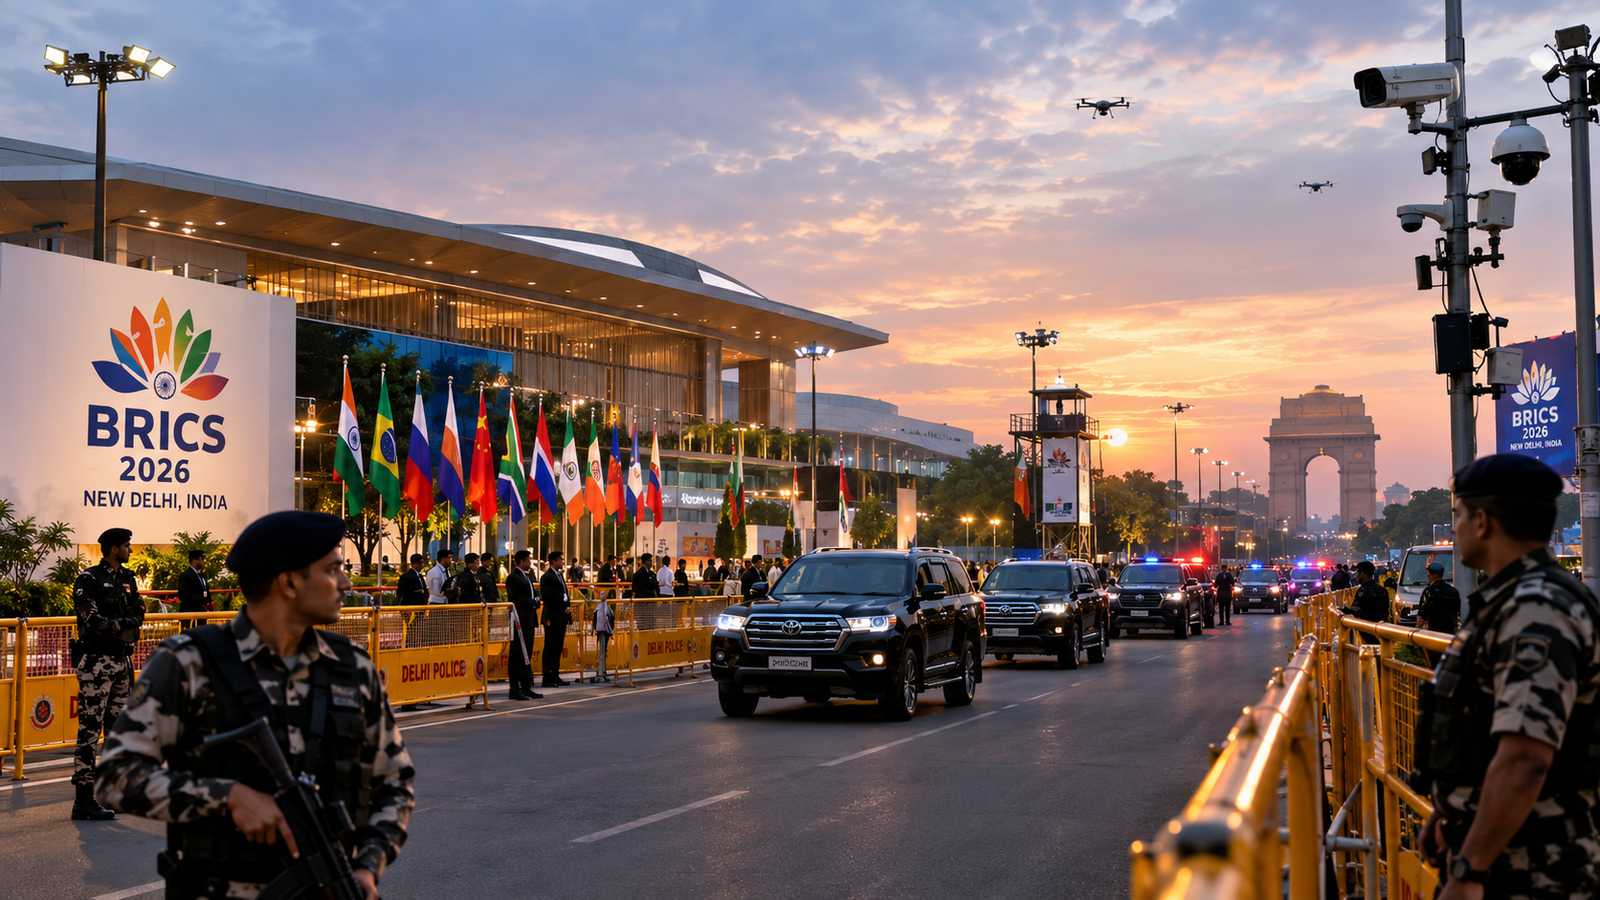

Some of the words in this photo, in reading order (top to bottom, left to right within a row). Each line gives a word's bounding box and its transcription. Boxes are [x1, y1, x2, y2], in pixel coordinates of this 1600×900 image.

[1512, 406, 1559, 427] BRICS
[87, 404, 226, 454] BRICS
[1522, 425, 1549, 439] 2026
[119, 456, 190, 483] 2026
[84, 490, 125, 507] NEW
[131, 492, 182, 511] DELHI,
[187, 494, 228, 510] INDIA
[402, 663, 430, 683] DELHI
[433, 660, 467, 679] POLICE
